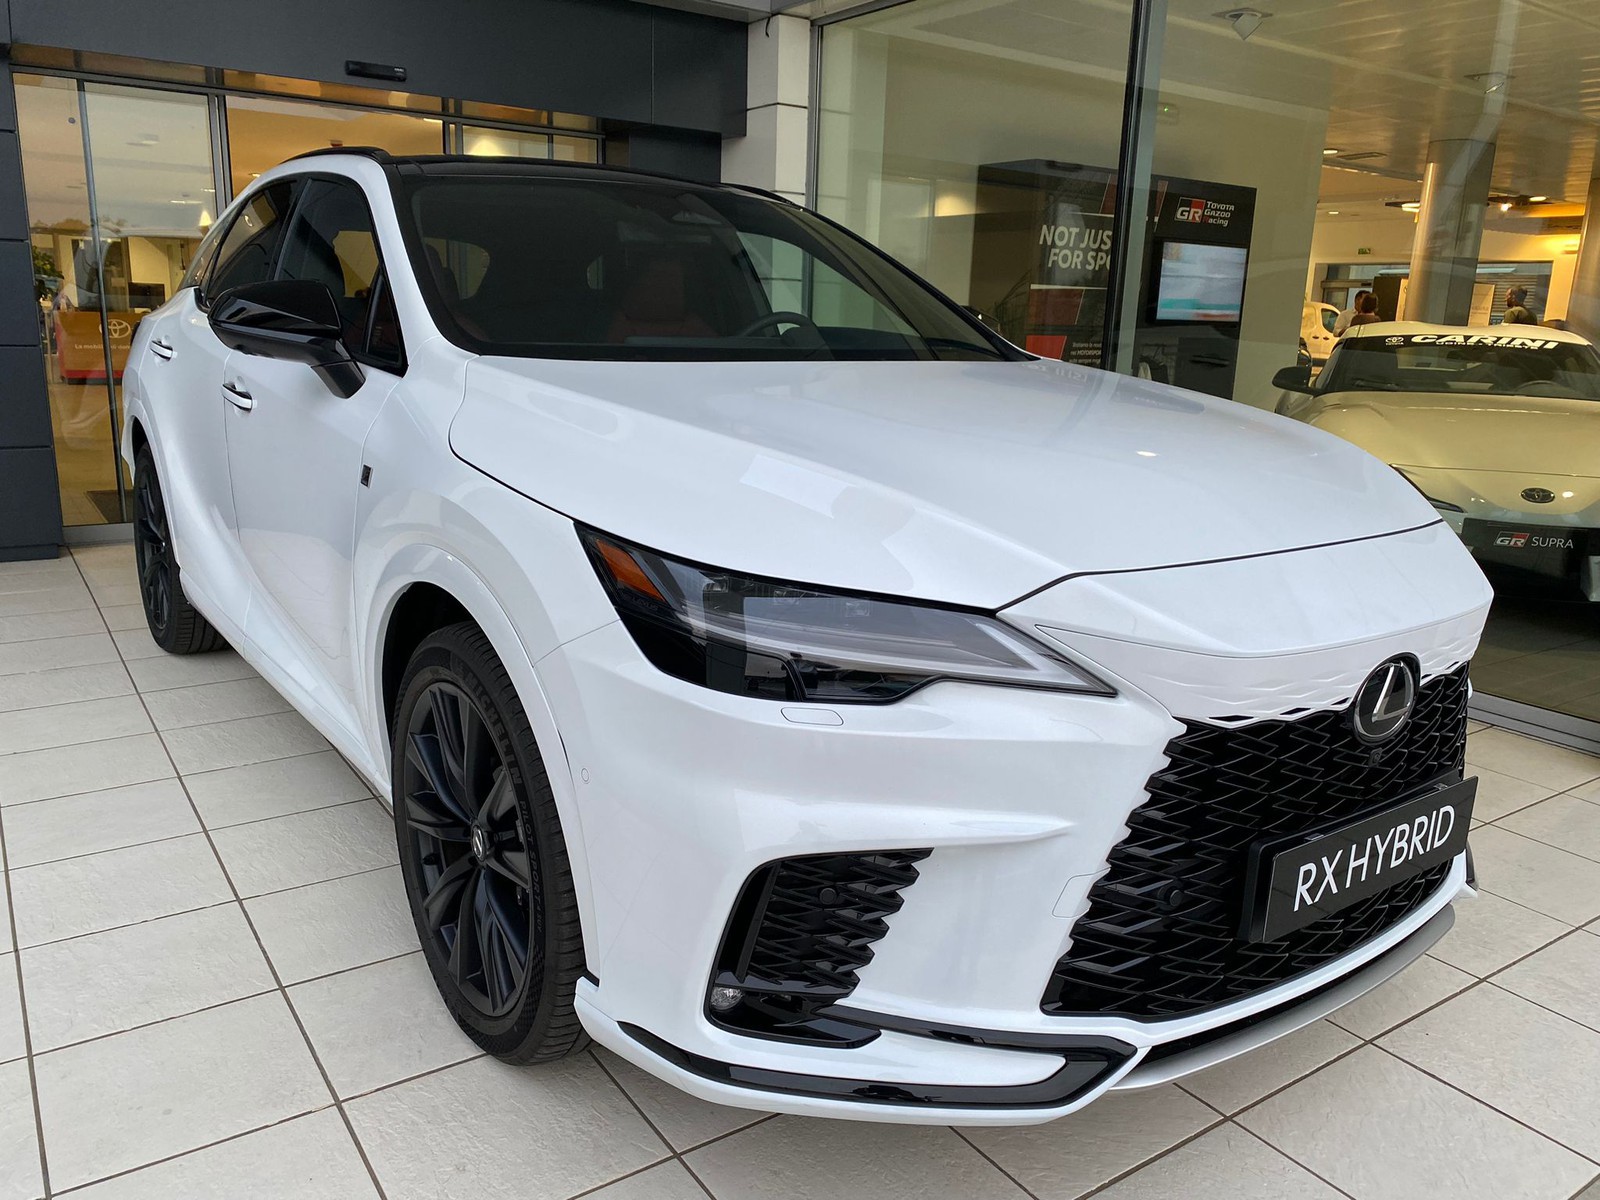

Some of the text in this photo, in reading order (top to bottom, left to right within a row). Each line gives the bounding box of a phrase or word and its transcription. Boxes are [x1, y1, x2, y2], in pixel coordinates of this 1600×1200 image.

[1176, 206, 1202, 223] GR
[1206, 200, 1235, 211] TOYOTA
[1039, 224, 1113, 250] NOT JUS
[1048, 248, 1083, 269] FOR
[1411, 334, 1559, 349] CARINI
[1496, 536, 1574, 549] GR SUPRA
[465, 671, 523, 785] MICHELIN
[519, 800, 534, 846] PILOT
[530, 851, 542, 905] SPORT
[1293, 805, 1455, 912] RX HYBRID
